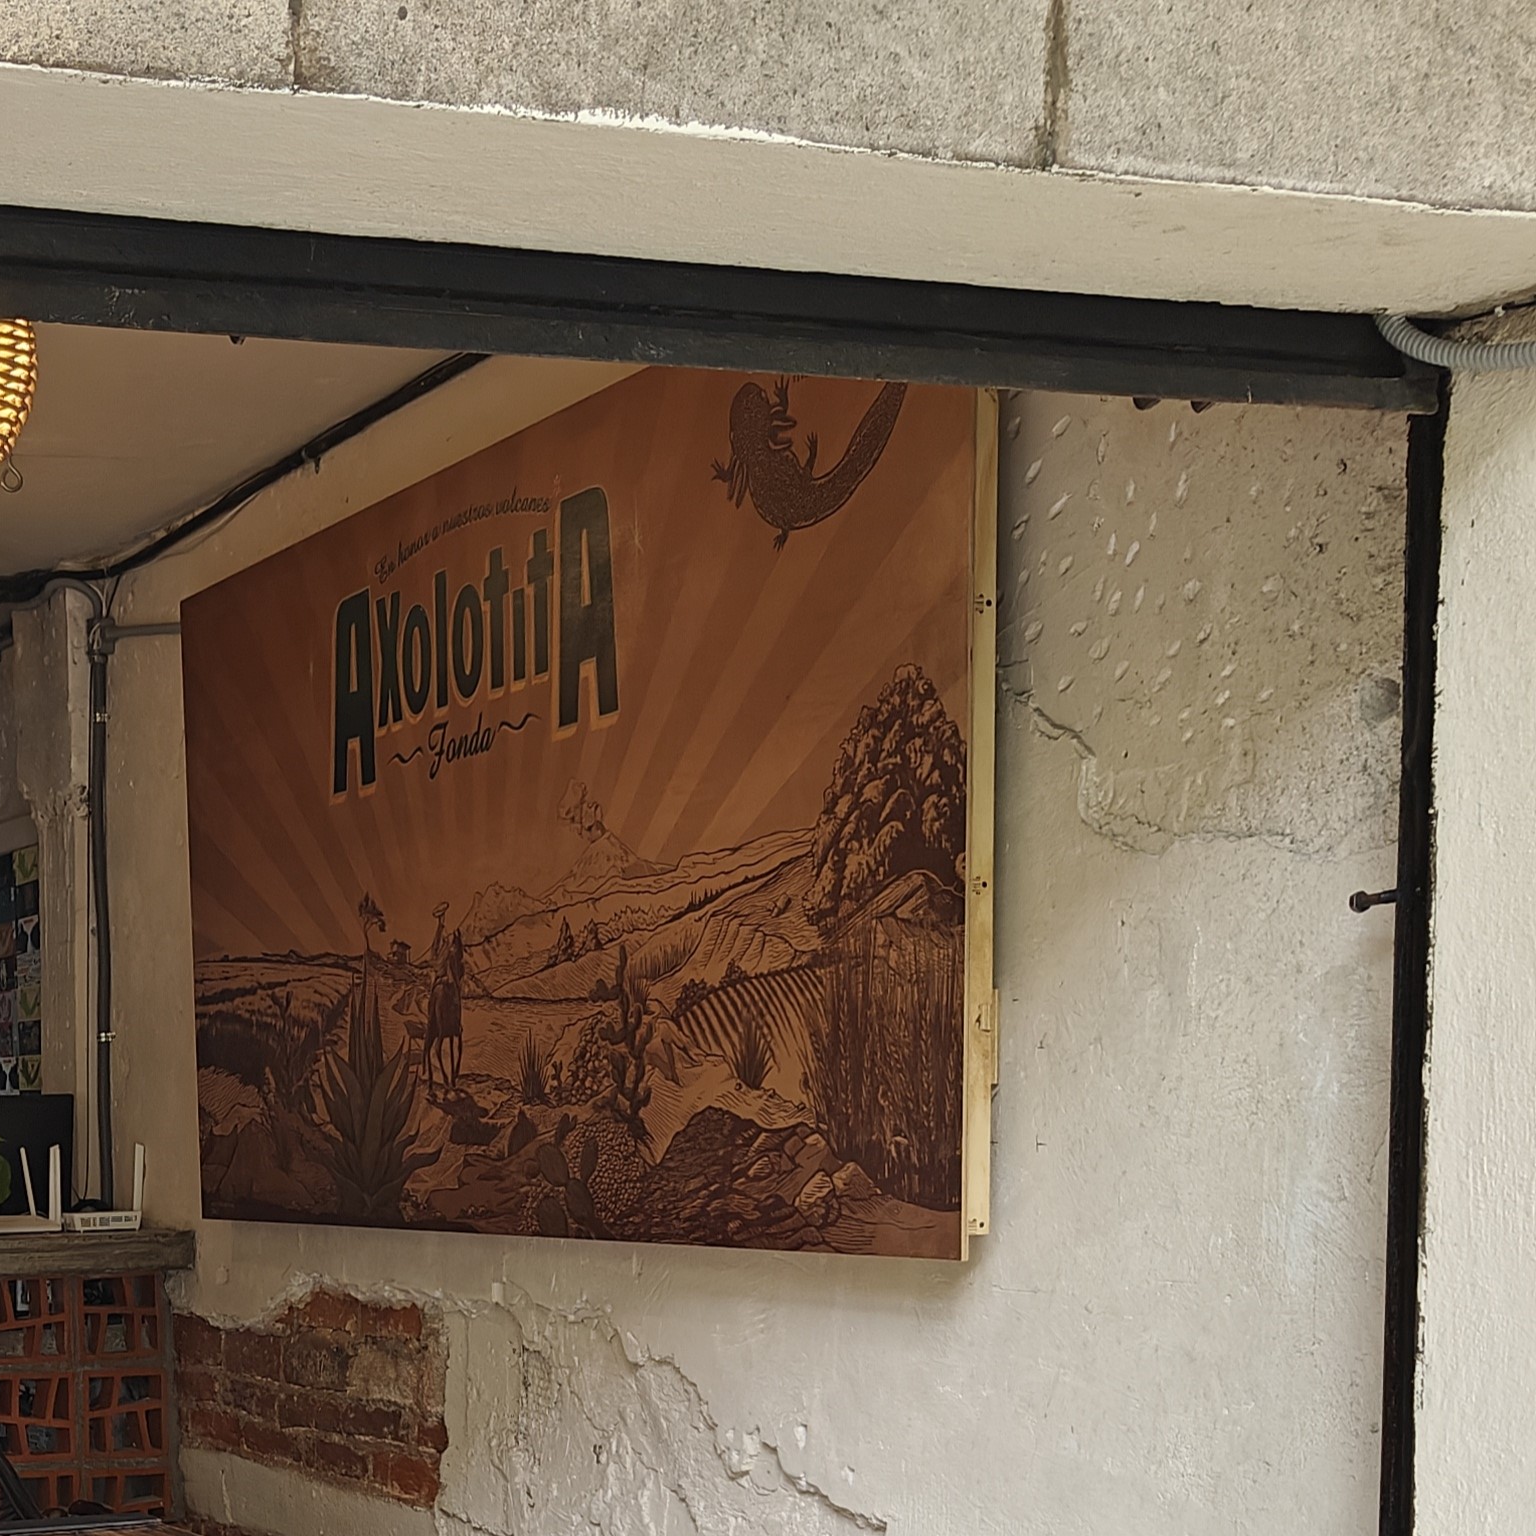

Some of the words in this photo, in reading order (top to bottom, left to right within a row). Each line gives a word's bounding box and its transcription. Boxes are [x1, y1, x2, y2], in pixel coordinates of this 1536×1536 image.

[374, 555, 397, 584] En
[397, 535, 429, 568] honor
[440, 502, 492, 535] nuestros
[495, 486, 551, 516] volcanes
[427, 712, 496, 780] Fonda
